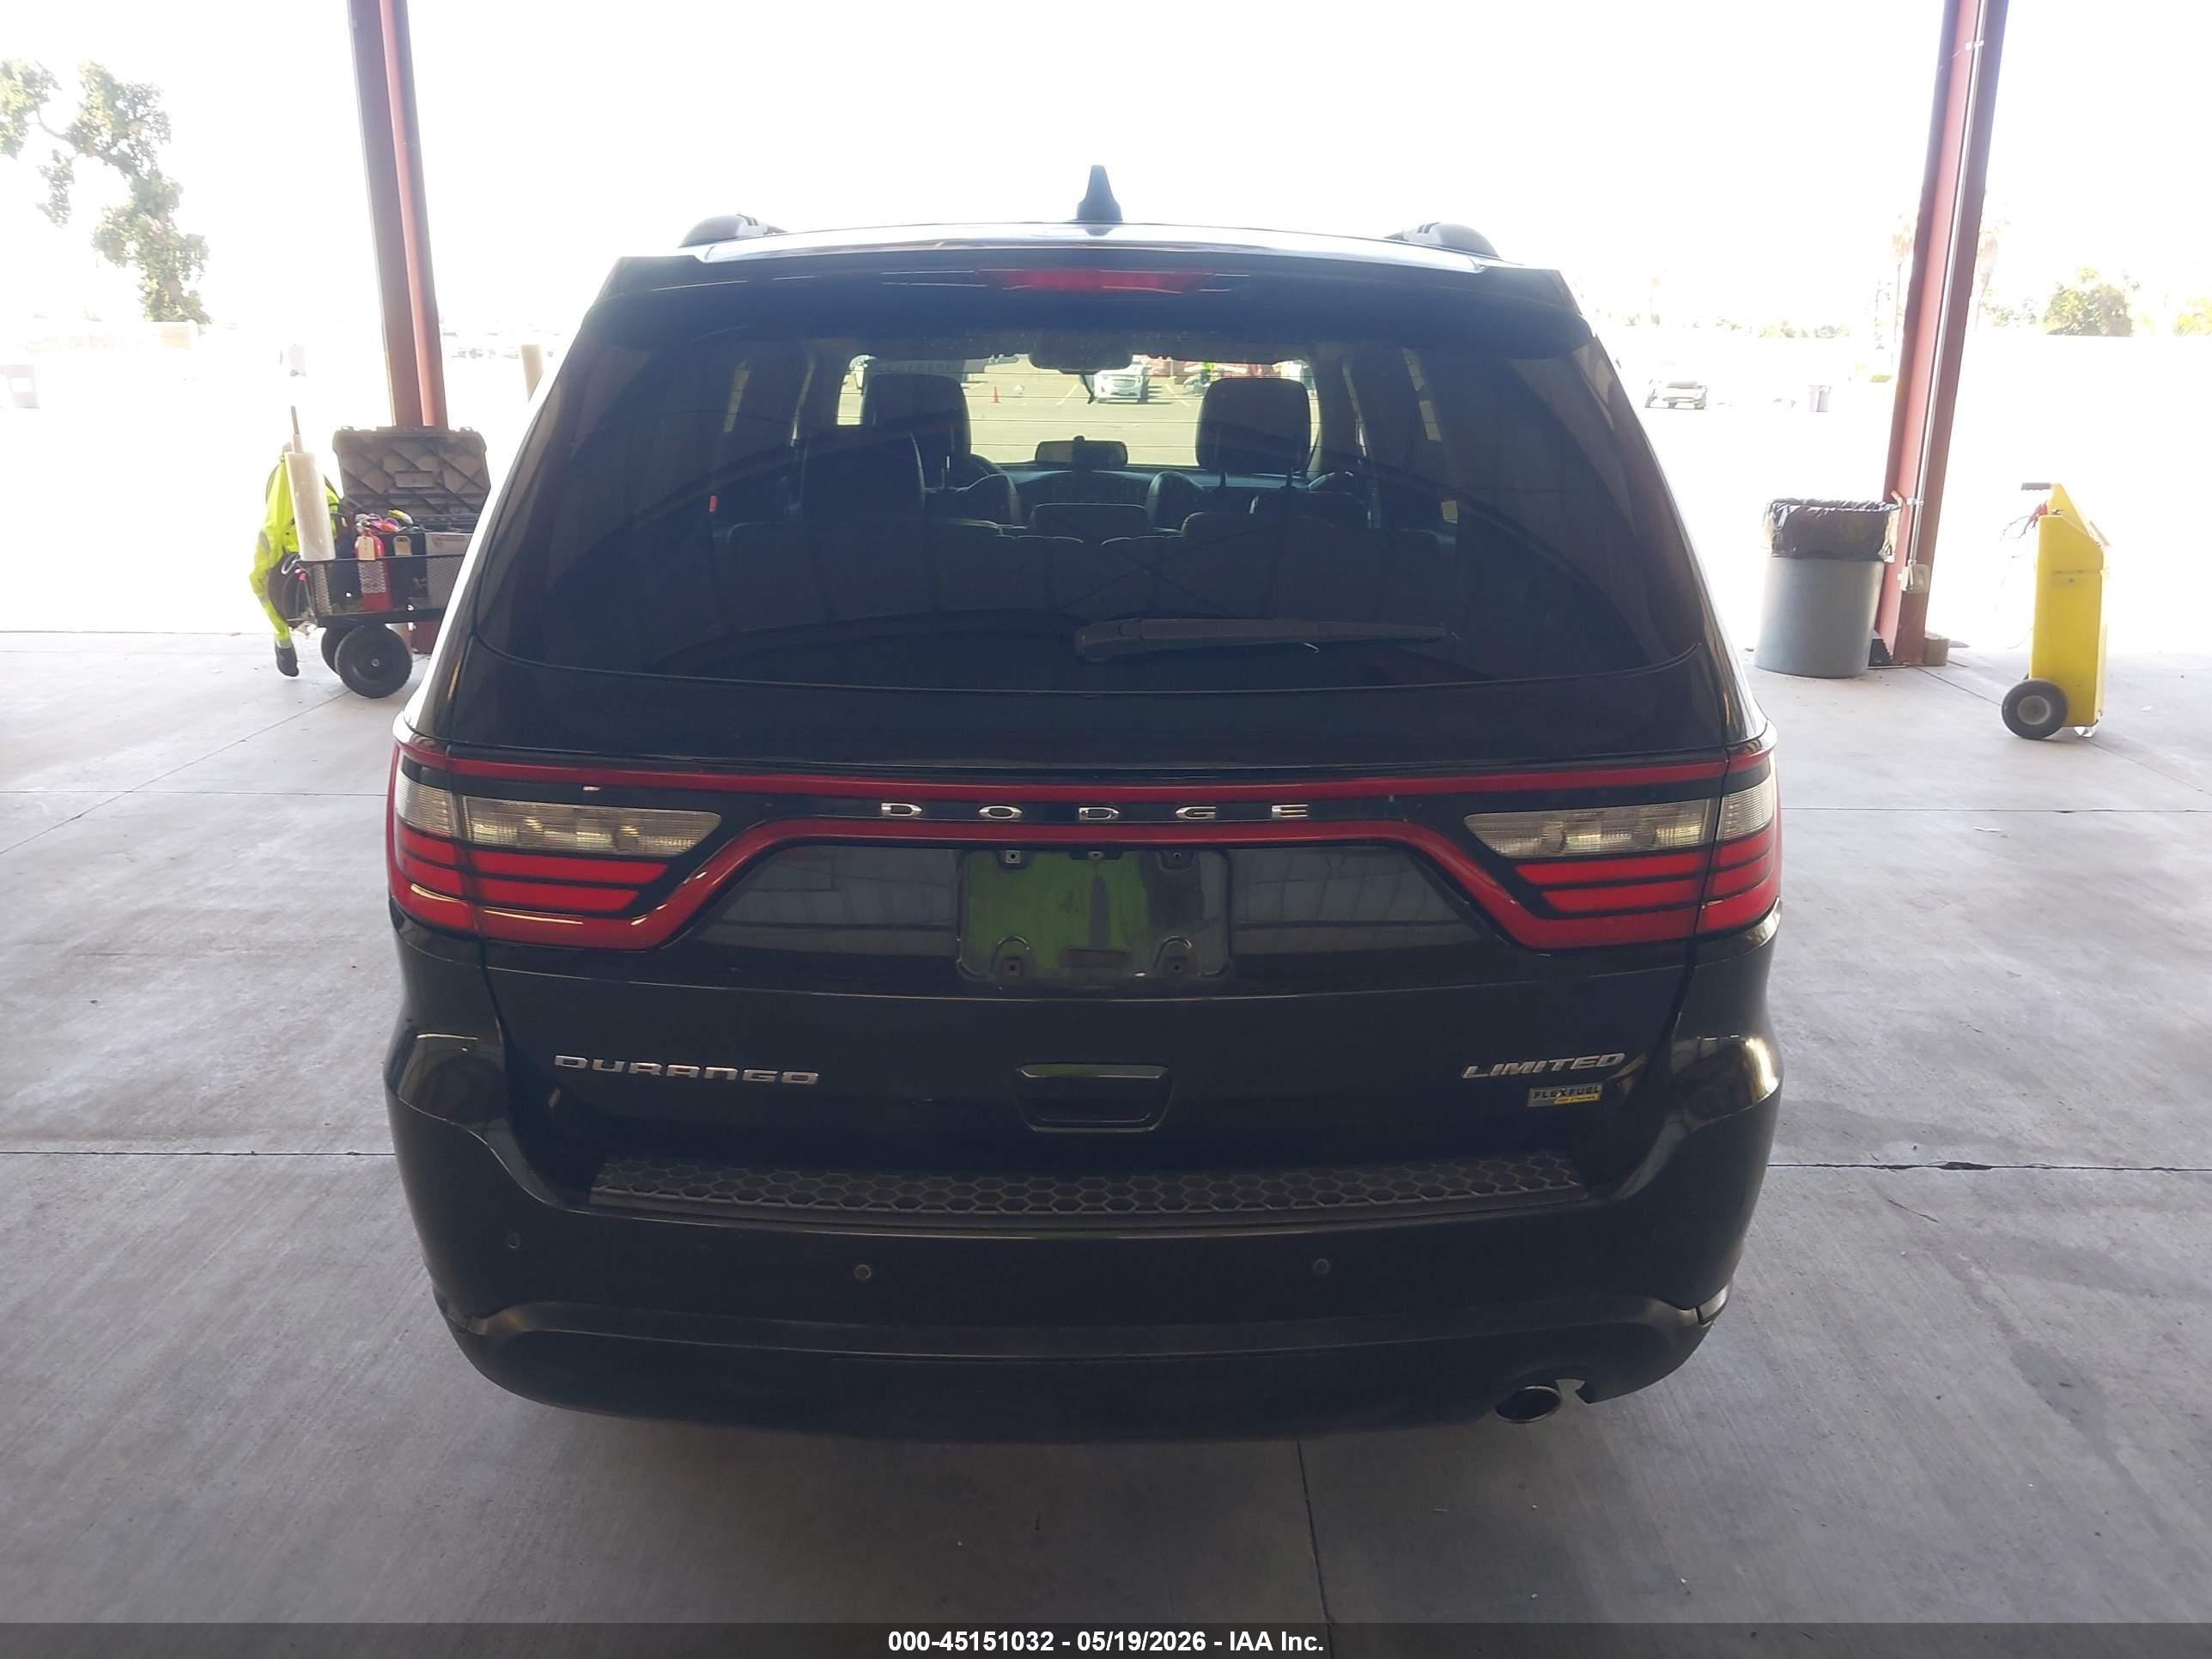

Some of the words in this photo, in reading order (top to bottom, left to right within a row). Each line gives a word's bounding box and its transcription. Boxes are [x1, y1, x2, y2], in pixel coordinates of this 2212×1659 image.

[881, 802, 1310, 820] DODGE
[554, 1054, 819, 1085] DURANGO
[1462, 1053, 1626, 1079] LIMITED
